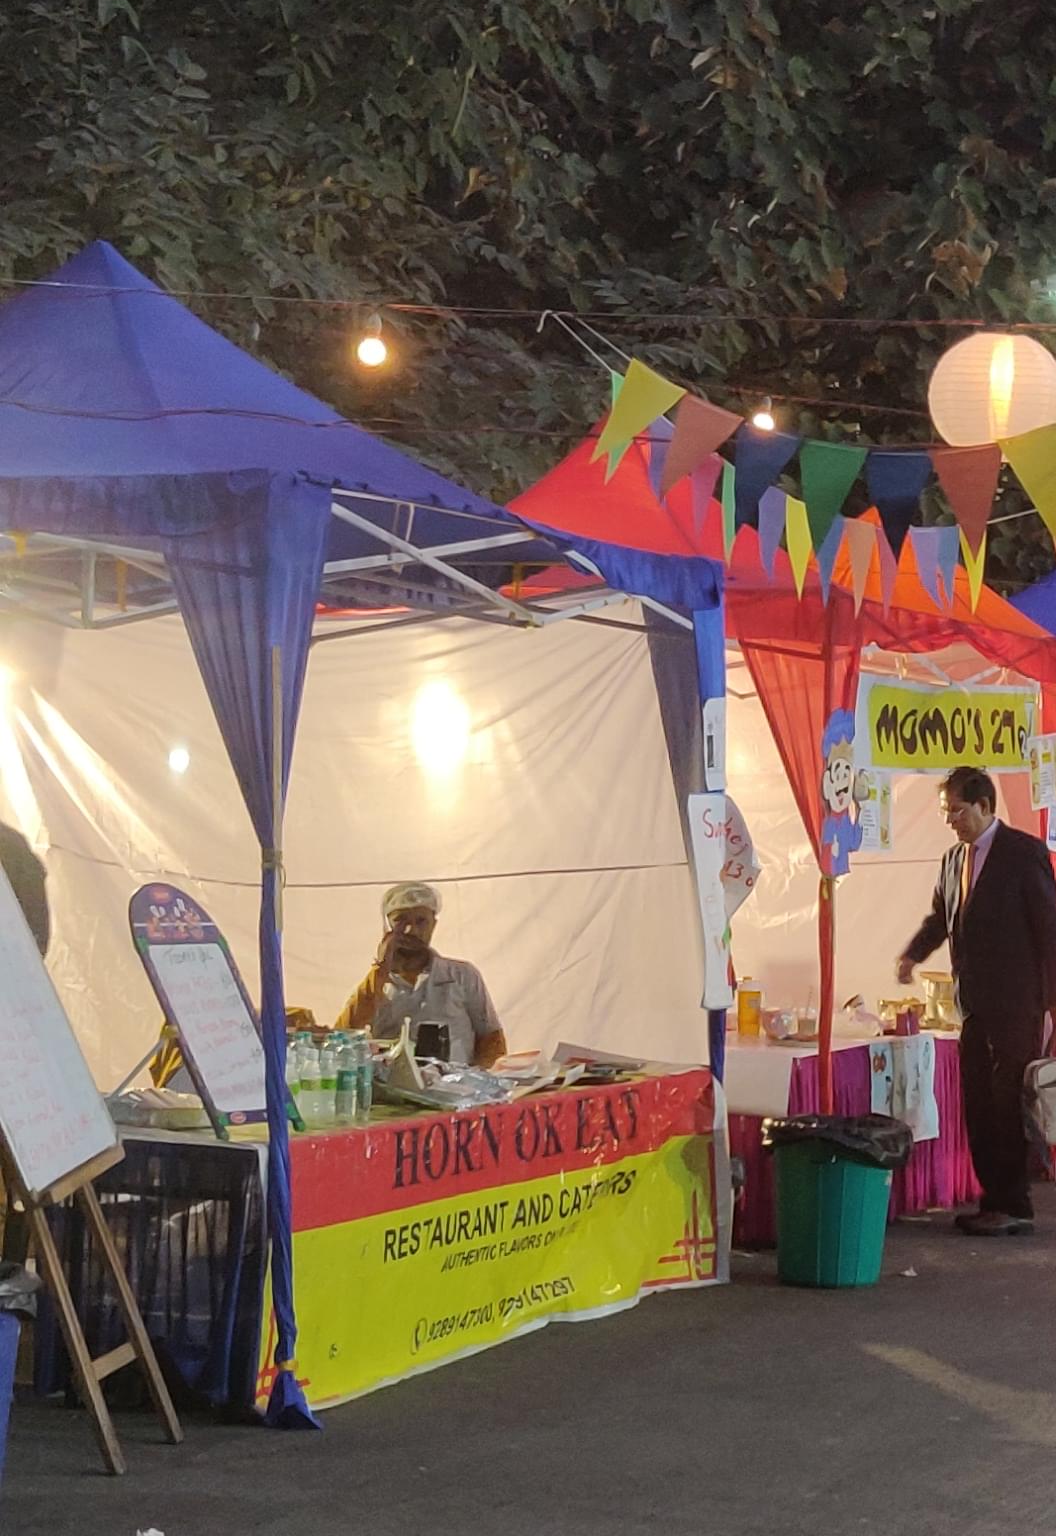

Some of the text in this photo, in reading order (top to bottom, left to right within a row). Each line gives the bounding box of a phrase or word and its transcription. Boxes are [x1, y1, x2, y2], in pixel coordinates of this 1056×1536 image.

[876, 703, 985, 755] MOMO'S
[392, 1088, 641, 1190] HORN OK EAT
[383, 1200, 509, 1263] RESTAURANT
[511, 1193, 554, 1229] AND
[440, 1245, 496, 1273] AUTHENTIC
[499, 1233, 542, 1257] FLAVORS
